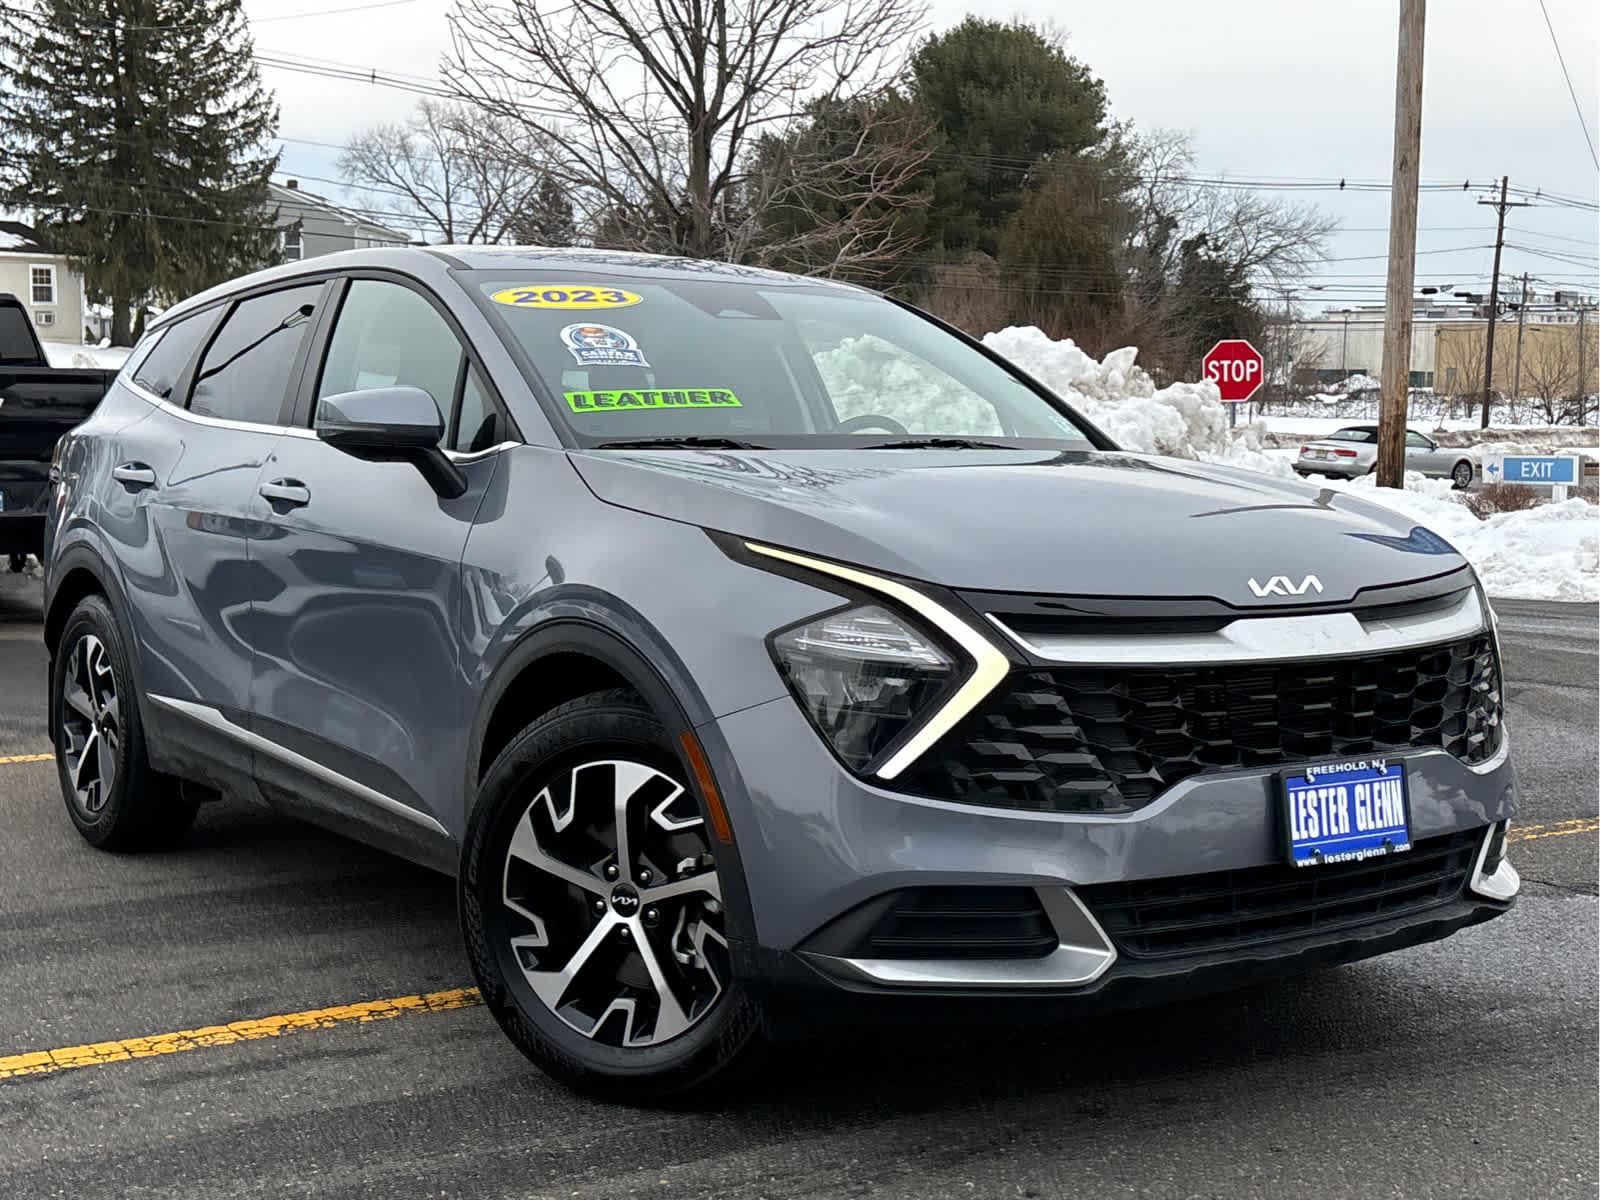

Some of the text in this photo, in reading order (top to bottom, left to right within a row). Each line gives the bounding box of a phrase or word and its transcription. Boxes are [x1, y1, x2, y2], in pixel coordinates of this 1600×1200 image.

[513, 290, 627, 303] 2023
[1208, 360, 1259, 382] STOP
[572, 391, 735, 409] LEATHER
[1521, 461, 1555, 478] EXIT
[1247, 575, 1324, 597] KIA
[1306, 761, 1369, 775] FREEHOLD,
[1289, 779, 1405, 841] LESTER GLENN
